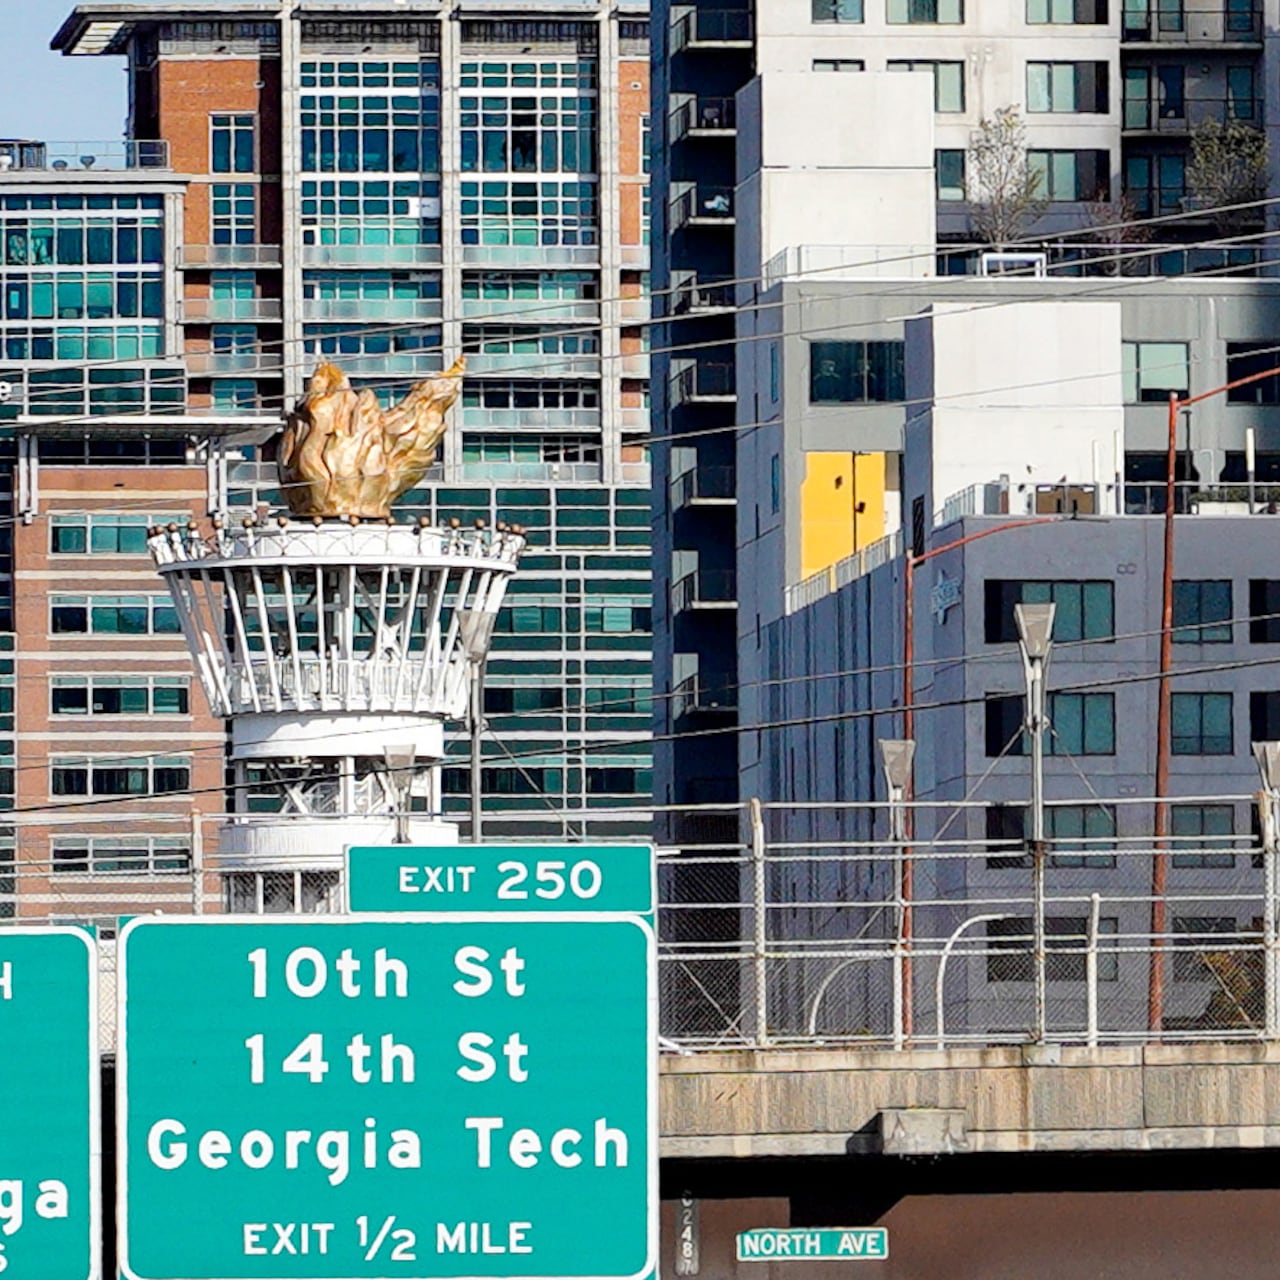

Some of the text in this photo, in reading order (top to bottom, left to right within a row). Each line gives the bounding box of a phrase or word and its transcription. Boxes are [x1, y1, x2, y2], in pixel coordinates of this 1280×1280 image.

[399, 860, 603, 899] EXIT 250
[247, 946, 526, 998] 10th St
[245, 1032, 529, 1084] 14th St
[147, 1116, 629, 1186] Georgia Tech
[243, 1223, 334, 1255] EXIT
[436, 1222, 533, 1254] MILE
[743, 1233, 881, 1256] NORTH AVE
